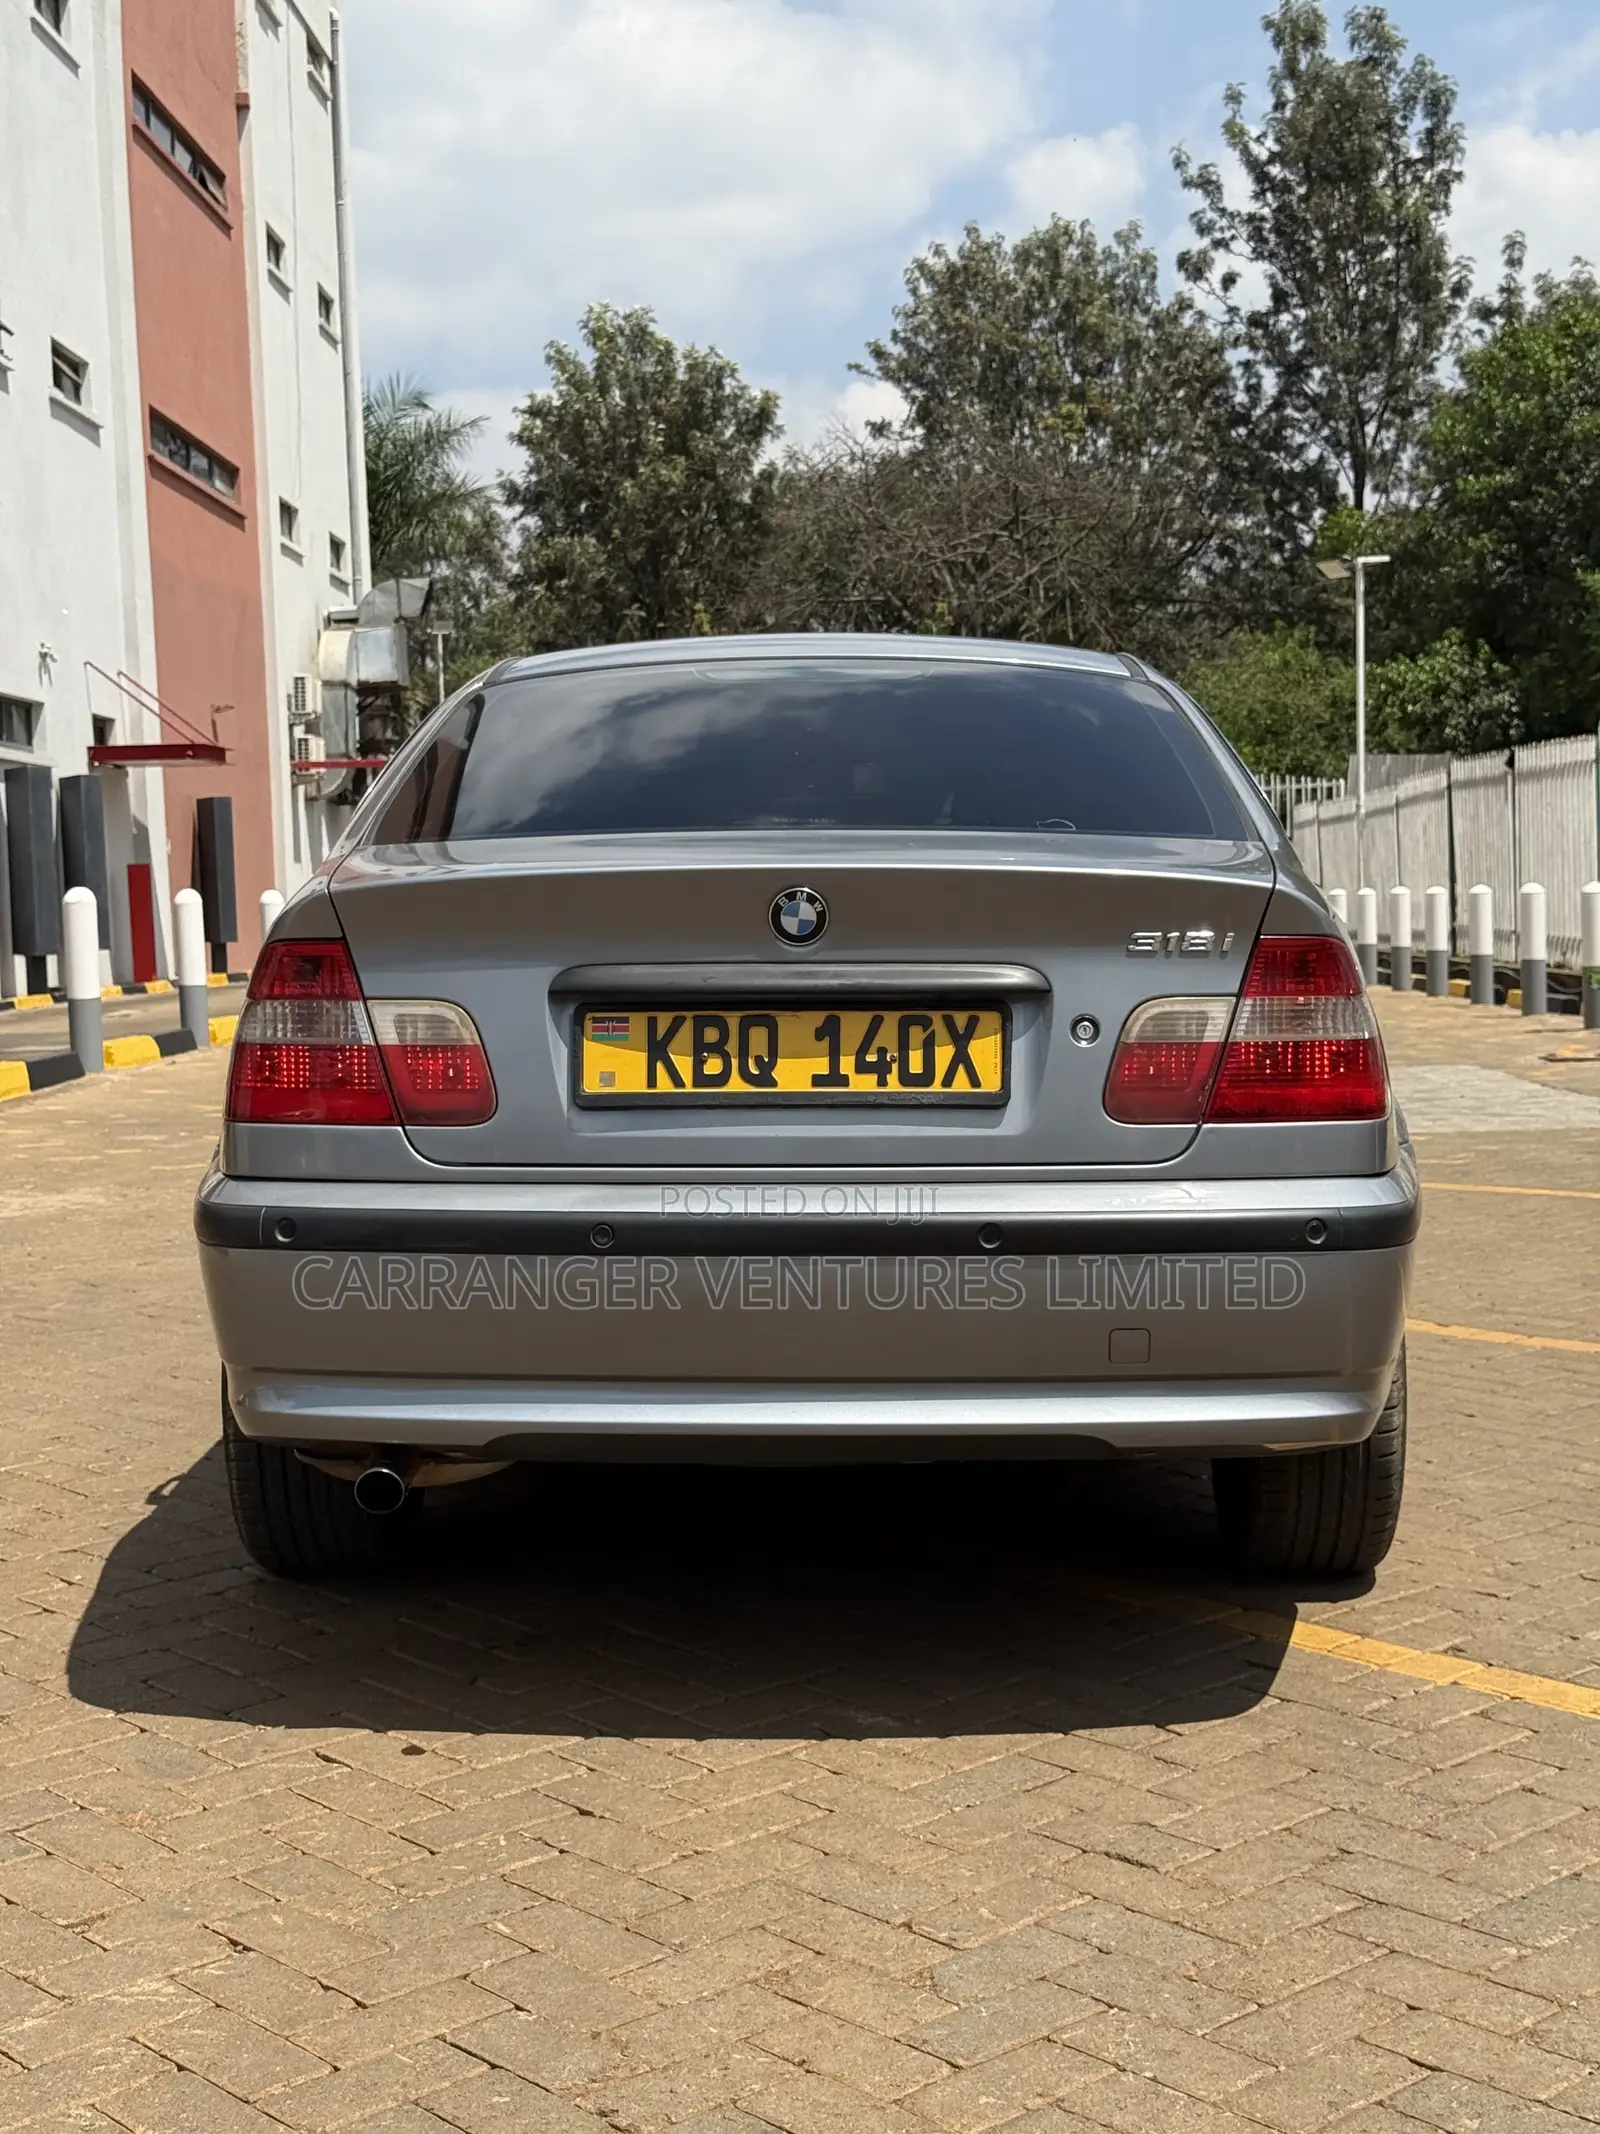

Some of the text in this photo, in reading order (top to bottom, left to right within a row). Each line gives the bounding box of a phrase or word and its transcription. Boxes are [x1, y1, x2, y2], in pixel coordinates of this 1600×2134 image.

[778, 891, 824, 912] BMW
[1127, 930, 1235, 952] 318i
[646, 1014, 778, 1088] KBQ
[811, 1014, 982, 1088] 140X
